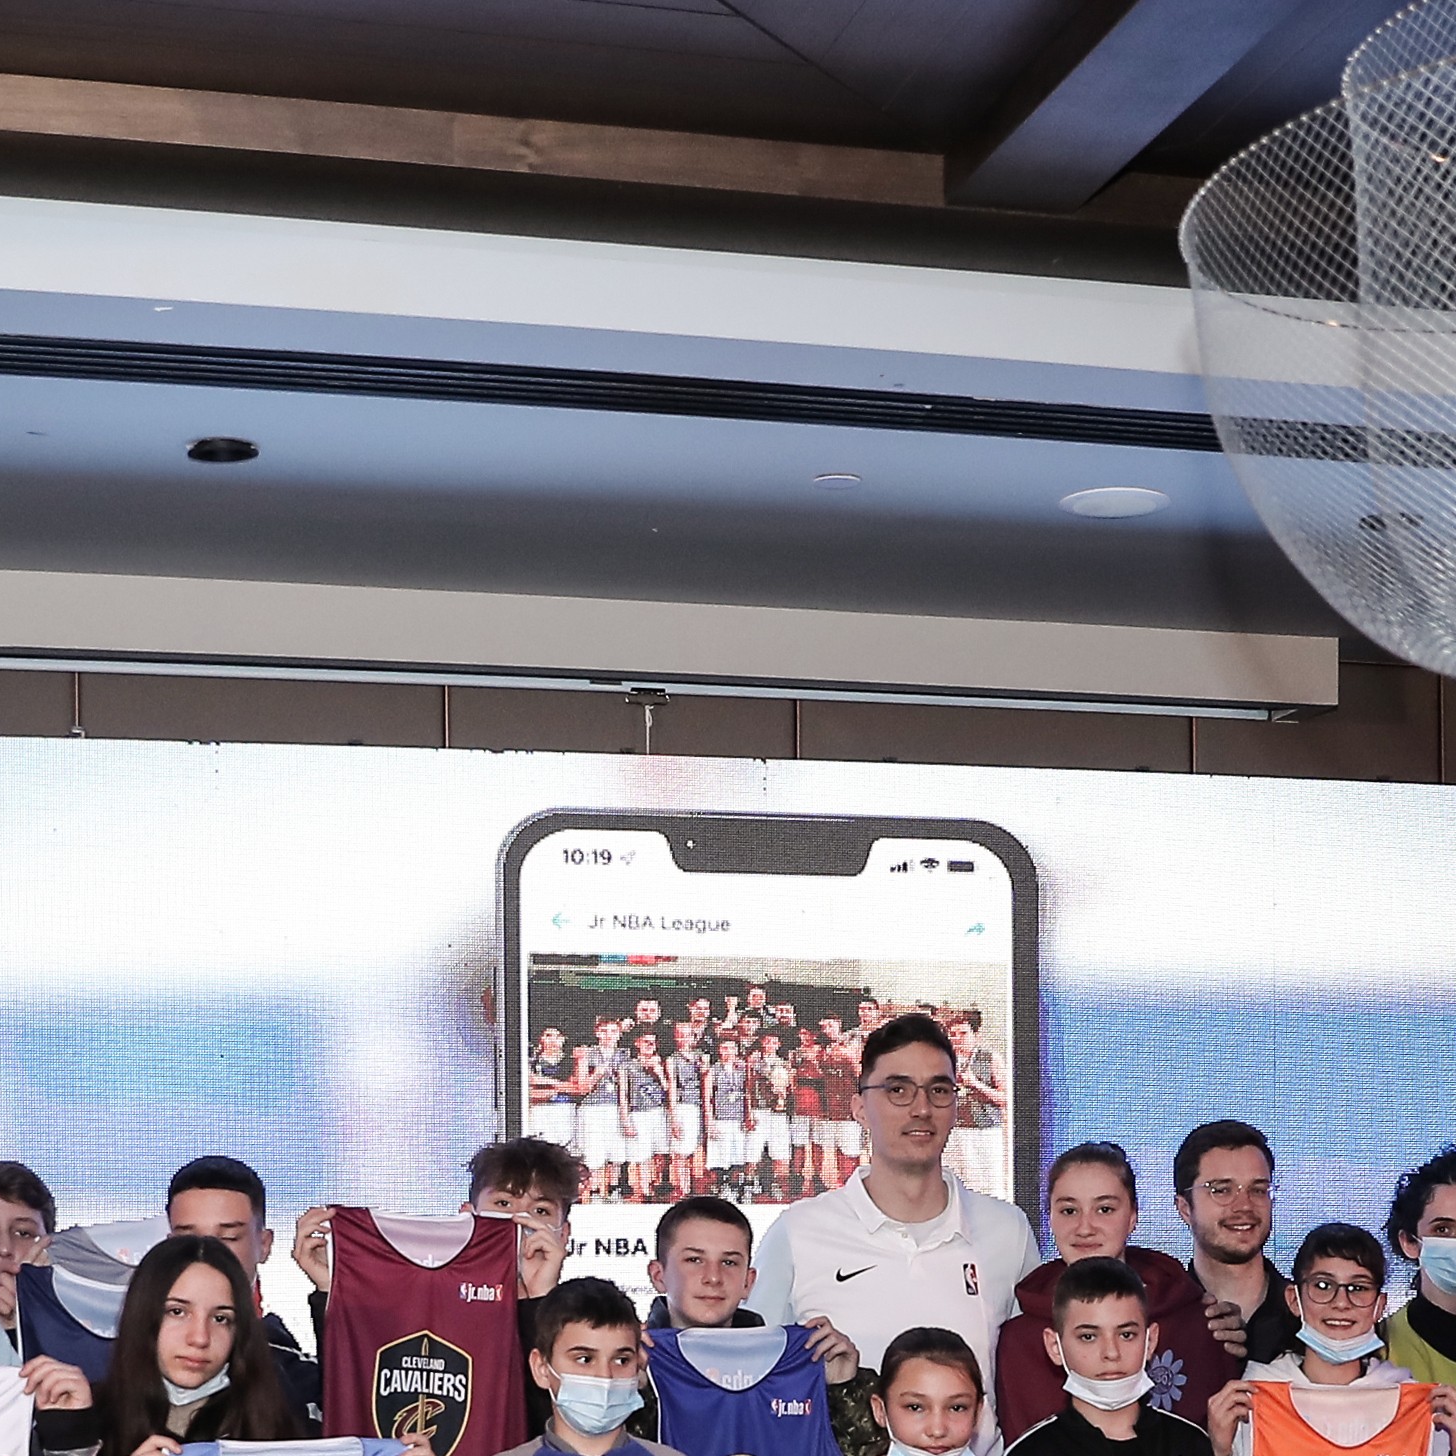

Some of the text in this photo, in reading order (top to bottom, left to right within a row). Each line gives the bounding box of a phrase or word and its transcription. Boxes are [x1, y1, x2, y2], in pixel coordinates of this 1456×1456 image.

[562, 849, 612, 866] 10:19
[588, 915, 731, 934] Jr NBA League
[595, 1238, 648, 1255] NBA
[402, 1356, 445, 1371] CLEVELAND
[379, 1369, 466, 1402] CAVALIERS
